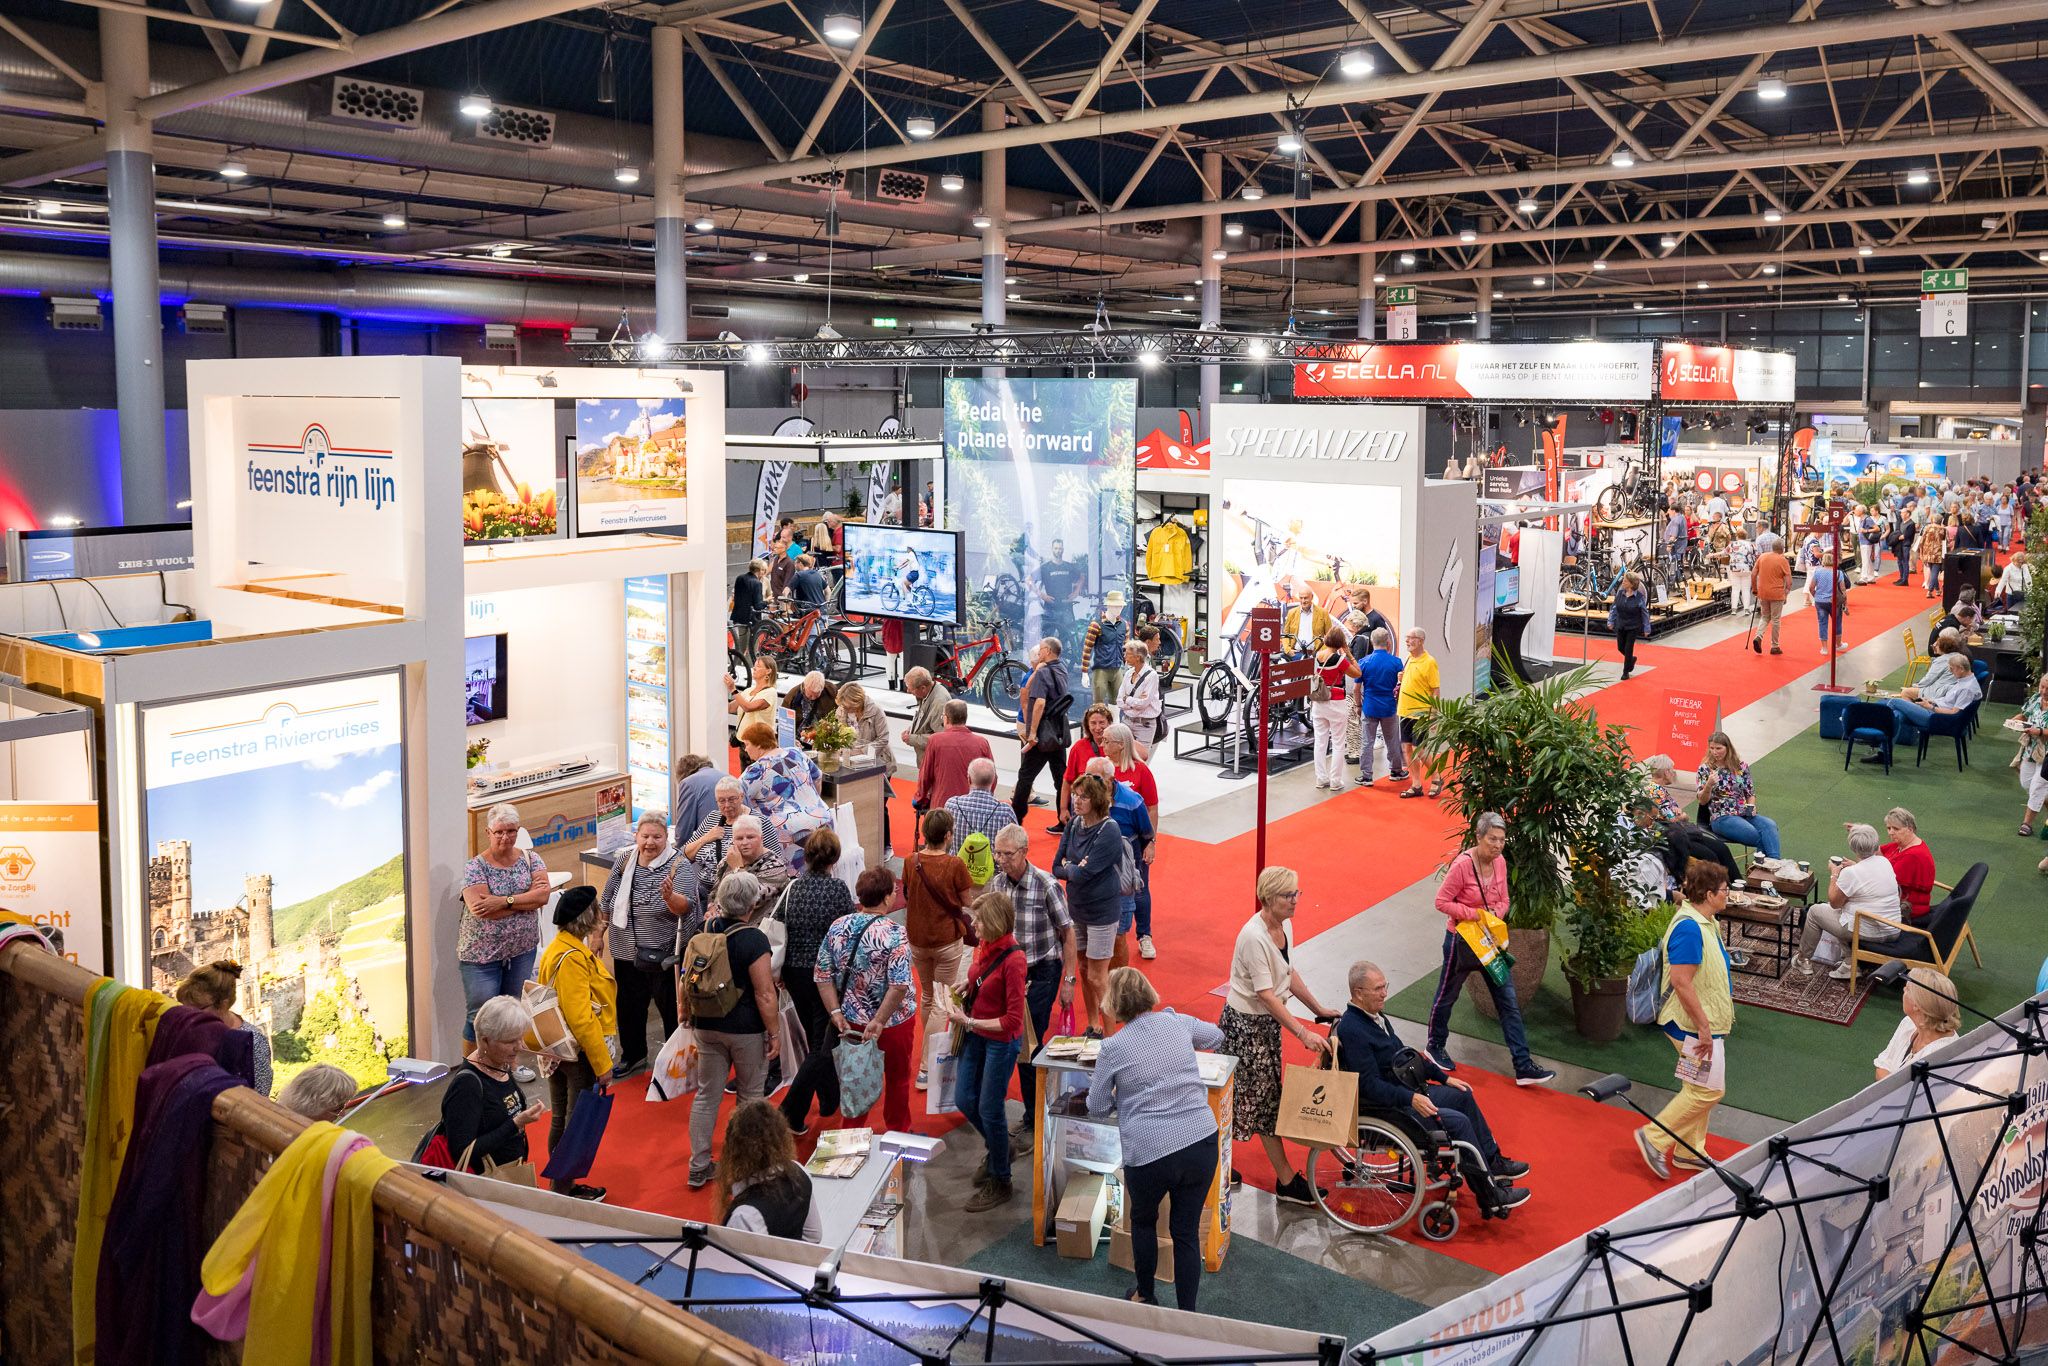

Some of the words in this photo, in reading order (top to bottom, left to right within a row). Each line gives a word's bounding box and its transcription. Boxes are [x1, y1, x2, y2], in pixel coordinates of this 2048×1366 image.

[1947, 309, 1953, 317] 8
[1402, 327, 1409, 340] B
[1945, 319, 1955, 335] C
[1470, 362, 1500, 370] ERVAAR
[1501, 362, 1517, 370] HET
[1519, 362, 1538, 370] ZELF
[1540, 362, 1551, 370] EN
[1531, 373, 1540, 381] JE
[958, 400, 1008, 422] Pedal
[1014, 401, 1042, 422] the
[958, 427, 1013, 451] planet
[1019, 428, 1093, 452] forward
[1219, 426, 1408, 462] SPECIALIZED
[247, 460, 321, 496] feenstra
[327, 465, 358, 507] rijn
[365, 467, 395, 510] lijn
[600, 516, 628, 525] Feenstra
[628, 514, 667, 523] Riviercruises
[1832, 510, 1840, 518] 8
[470, 599, 495, 620] lijn
[1259, 627, 1272, 642] 8
[171, 741, 258, 768] Feenstra
[265, 720, 380, 752] Riviercruises
[8, 883, 36, 893] ZorgBij
